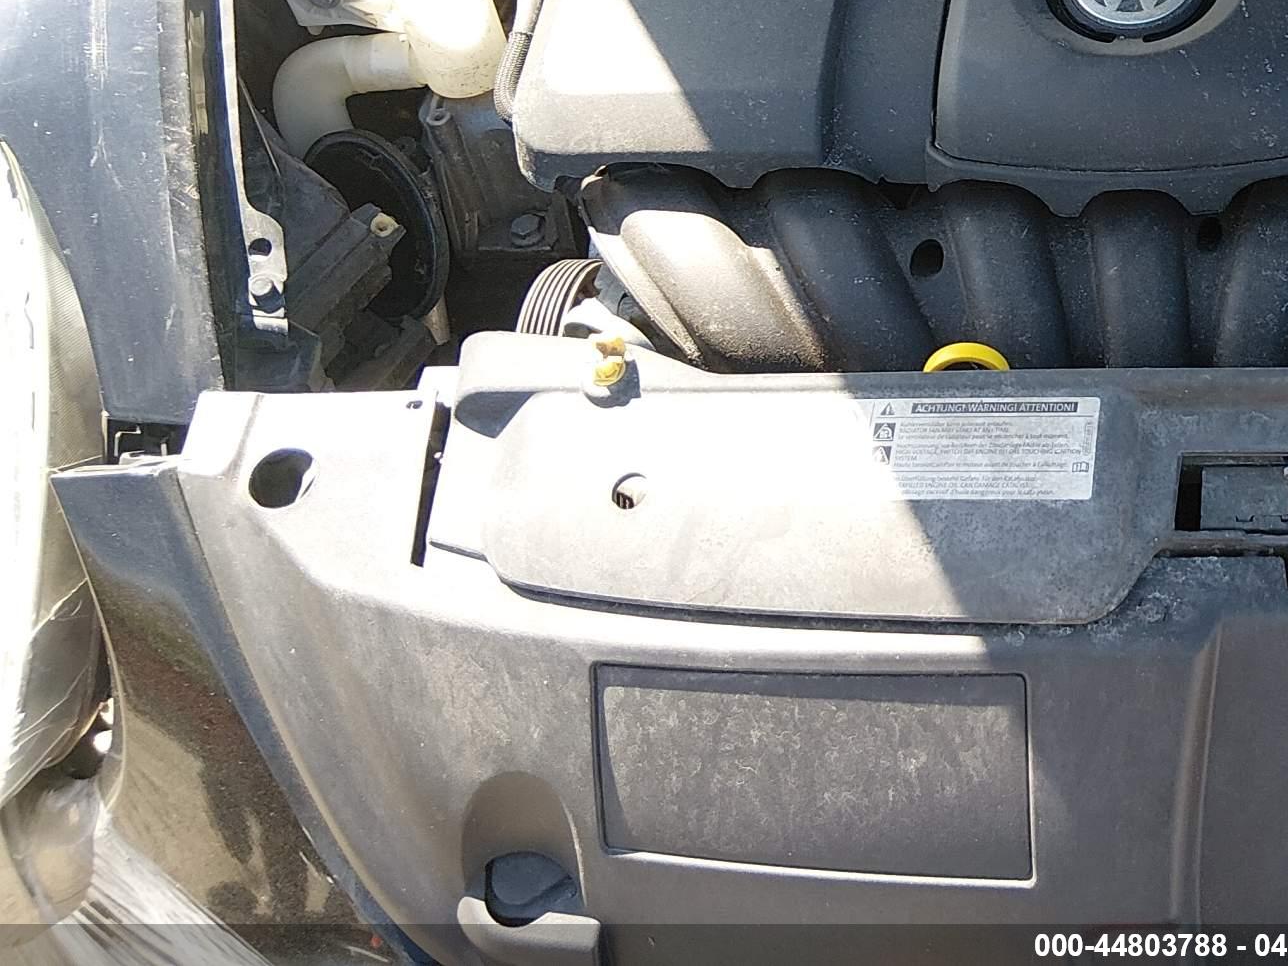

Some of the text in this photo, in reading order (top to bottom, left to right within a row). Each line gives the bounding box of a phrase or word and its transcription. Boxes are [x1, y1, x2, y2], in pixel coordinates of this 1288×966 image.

[915, 402, 1075, 413] ACHTUNG! WARNING! ATTENTION!
